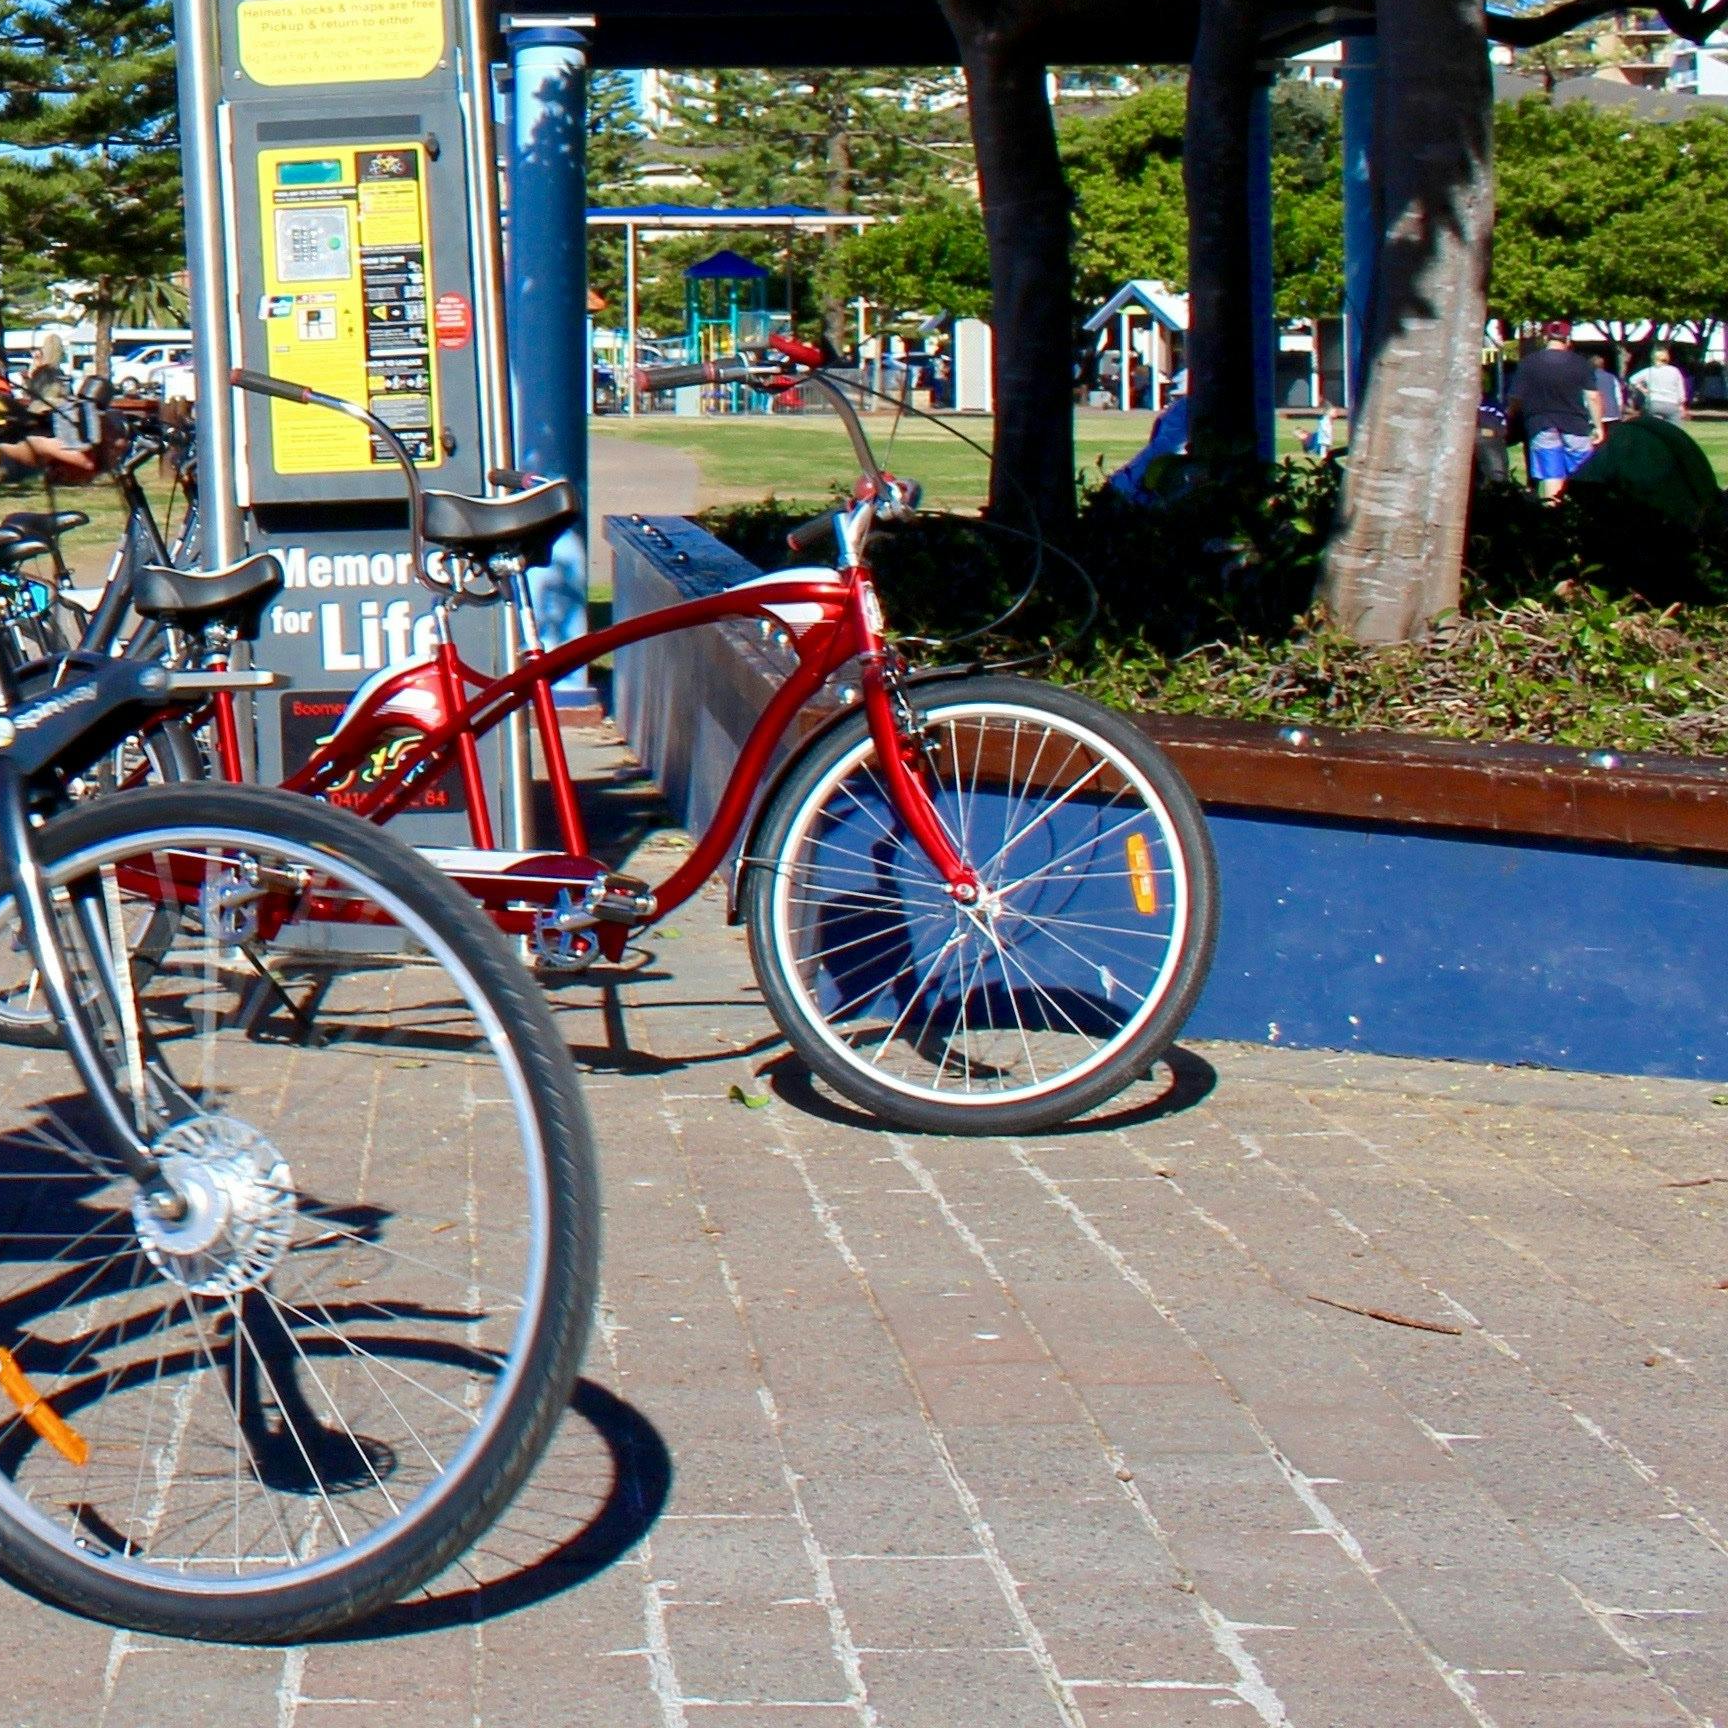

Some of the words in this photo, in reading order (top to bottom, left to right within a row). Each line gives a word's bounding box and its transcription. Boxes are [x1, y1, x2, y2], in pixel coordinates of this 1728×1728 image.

[389, 2, 408, 10] are
[412, 0, 436, 9] free
[362, 18, 376, 27] to
[271, 605, 313, 634] for
